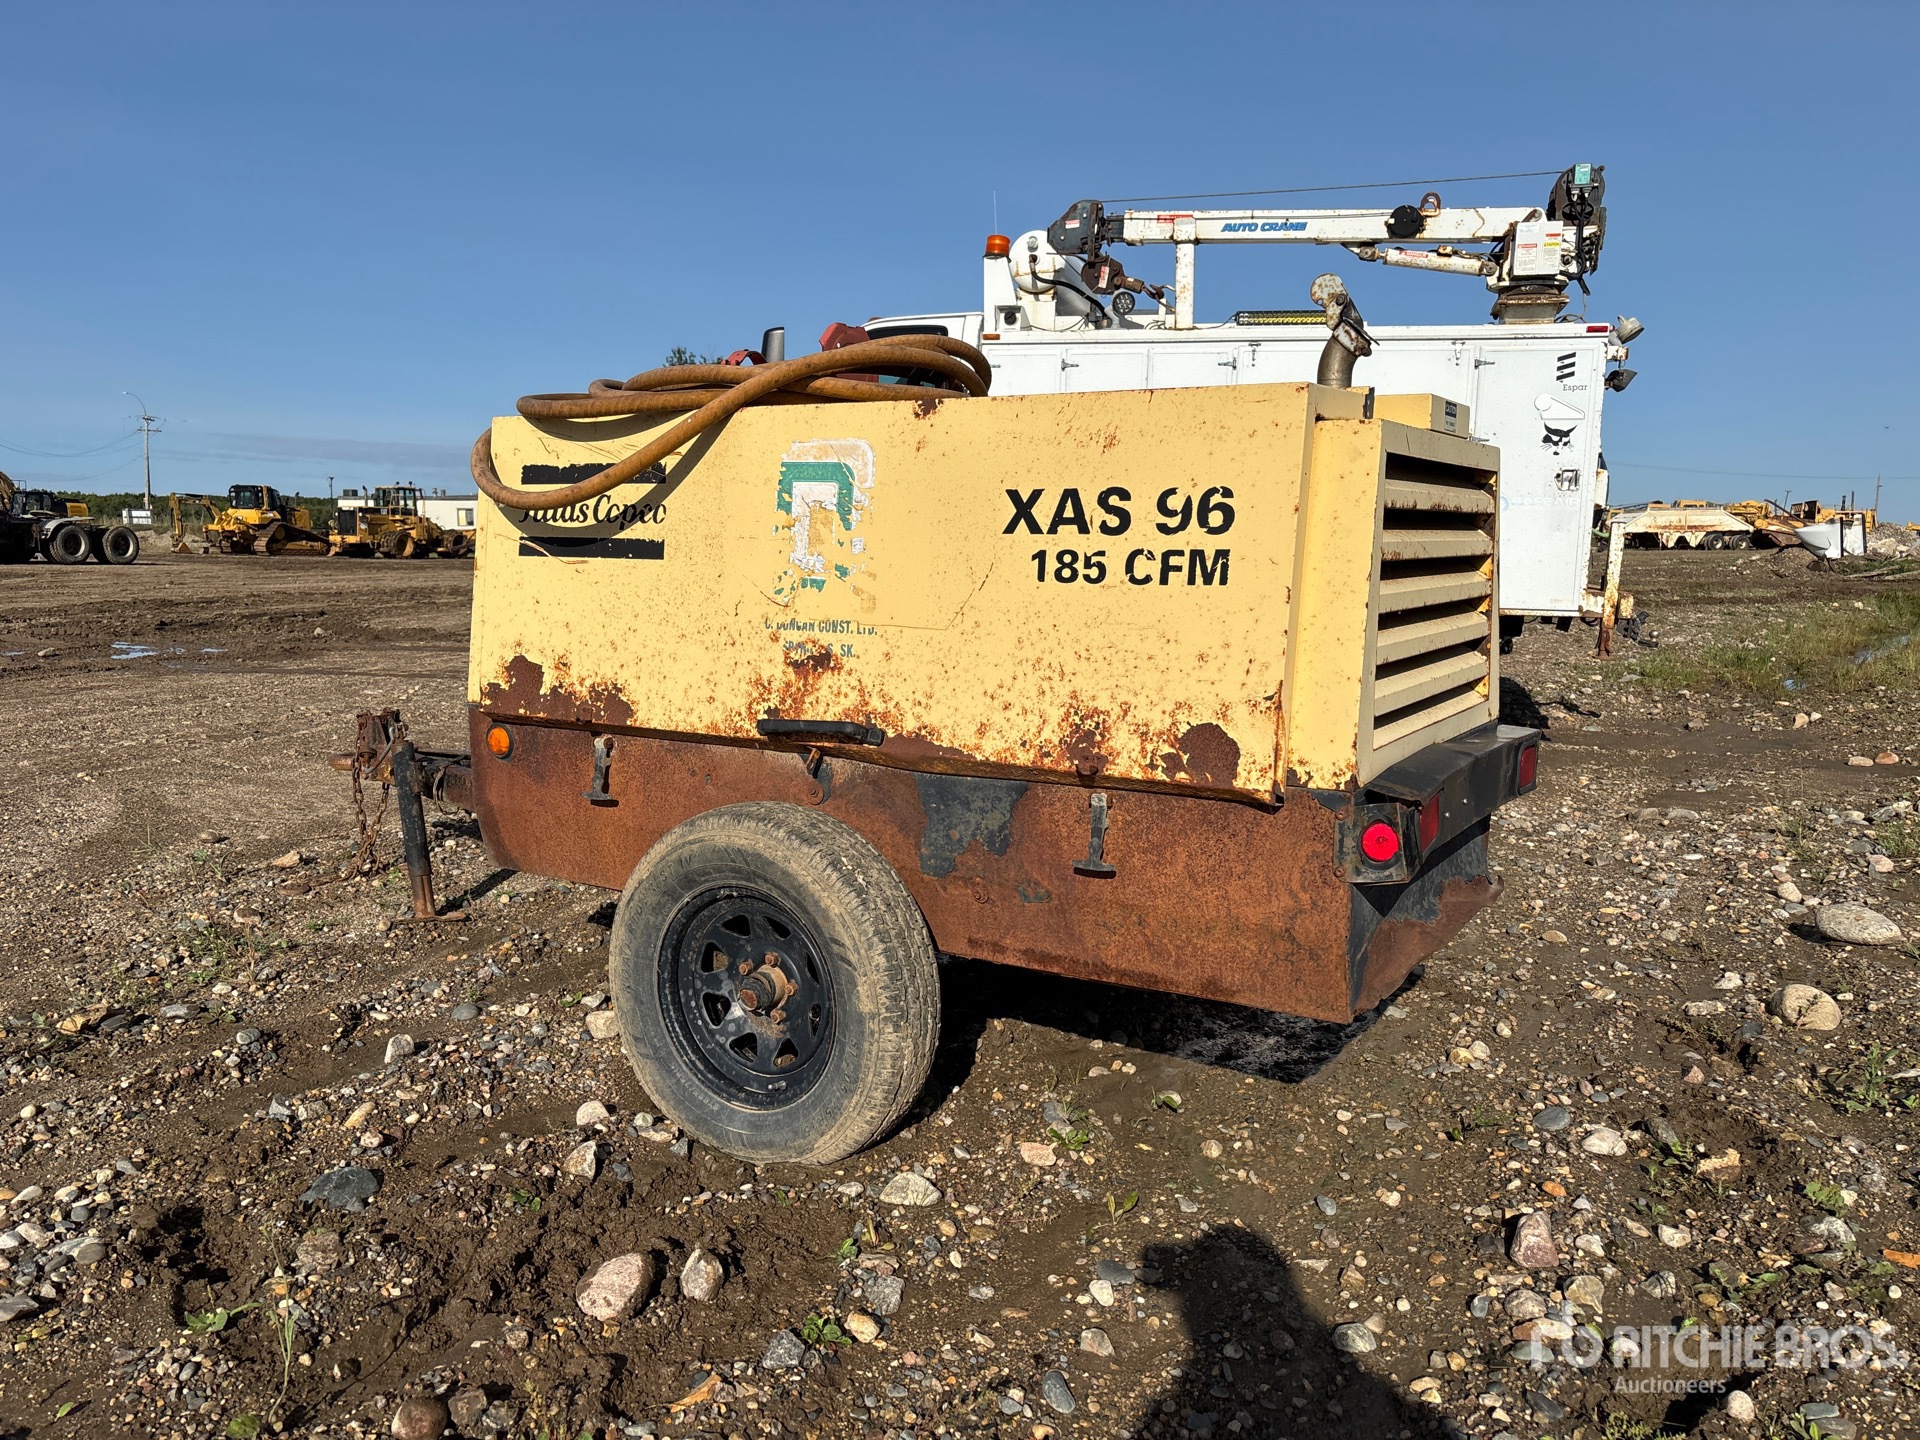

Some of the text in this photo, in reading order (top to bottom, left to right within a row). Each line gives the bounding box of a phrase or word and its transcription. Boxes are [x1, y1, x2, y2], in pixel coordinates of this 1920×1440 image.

[1220, 221, 1308, 232] AUTO CRANE
[1563, 384, 1587, 392] Espar
[593, 494, 667, 530] Copco
[1002, 486, 1236, 536] XAS 96
[1031, 548, 1231, 586] 185 CFM
[818, 619, 853, 634] CONST.
